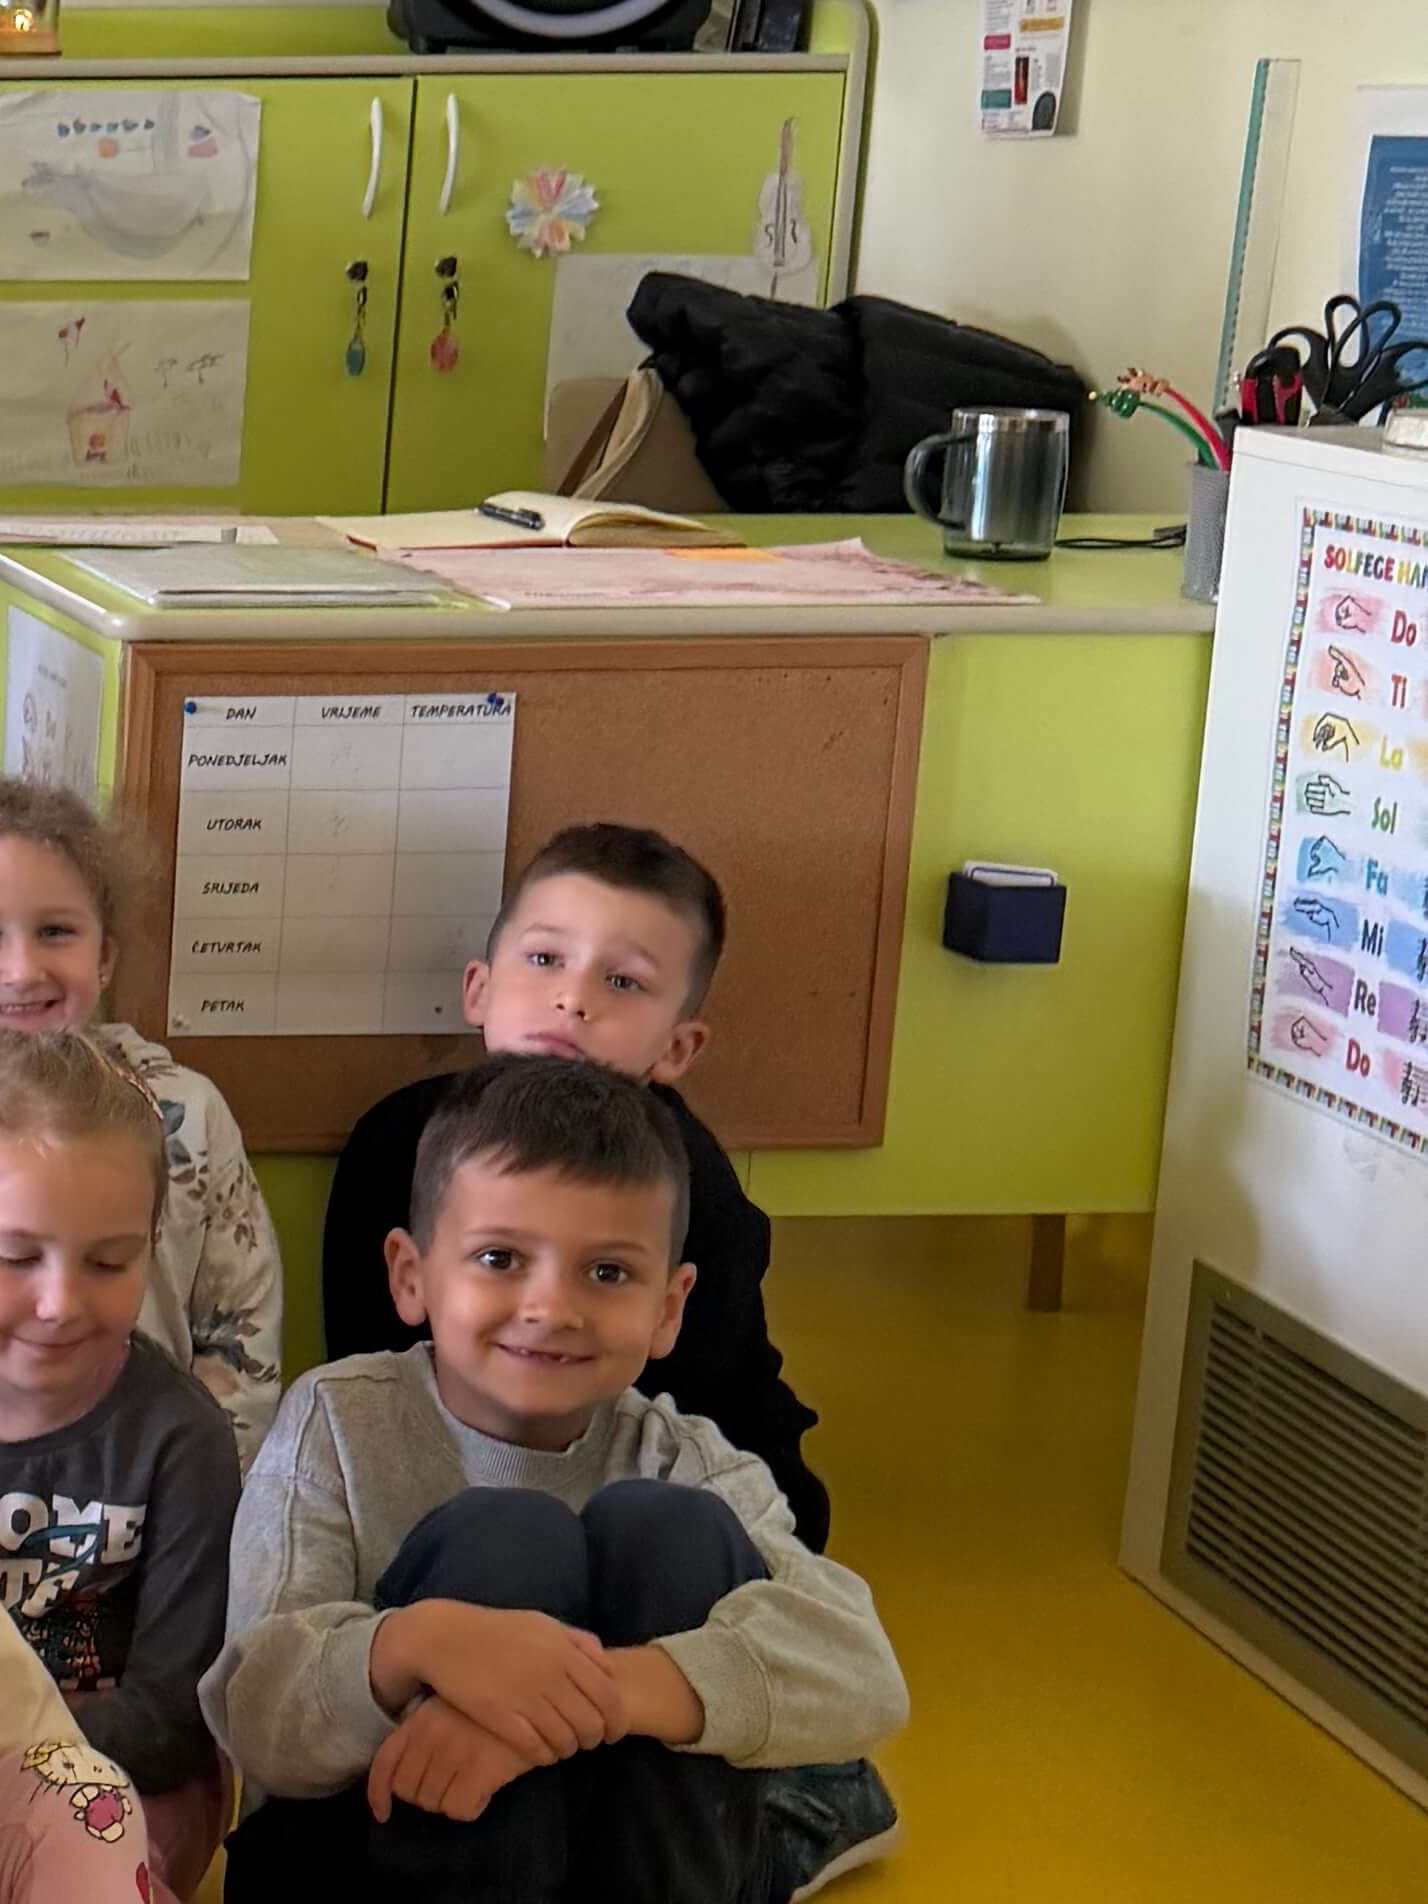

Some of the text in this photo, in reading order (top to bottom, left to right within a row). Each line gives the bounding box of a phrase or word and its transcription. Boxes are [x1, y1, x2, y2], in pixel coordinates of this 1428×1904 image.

[1390, 610, 1417, 646] Do
[225, 703, 512, 720] DAN VRIJEME TEMPERATURA
[188, 753, 288, 768] PONEDJELJAK
[1379, 735, 1403, 769] La
[206, 818, 263, 831] UTORAK
[1371, 797, 1398, 834] Sol
[202, 881, 260, 895] SRIJEDA
[1366, 857, 1388, 896] Fa
[1361, 919, 1384, 957] Mi
[200, 999, 245, 1013] PETAK
[1354, 979, 1377, 1016] Re
[1346, 1038, 1371, 1078] Do
